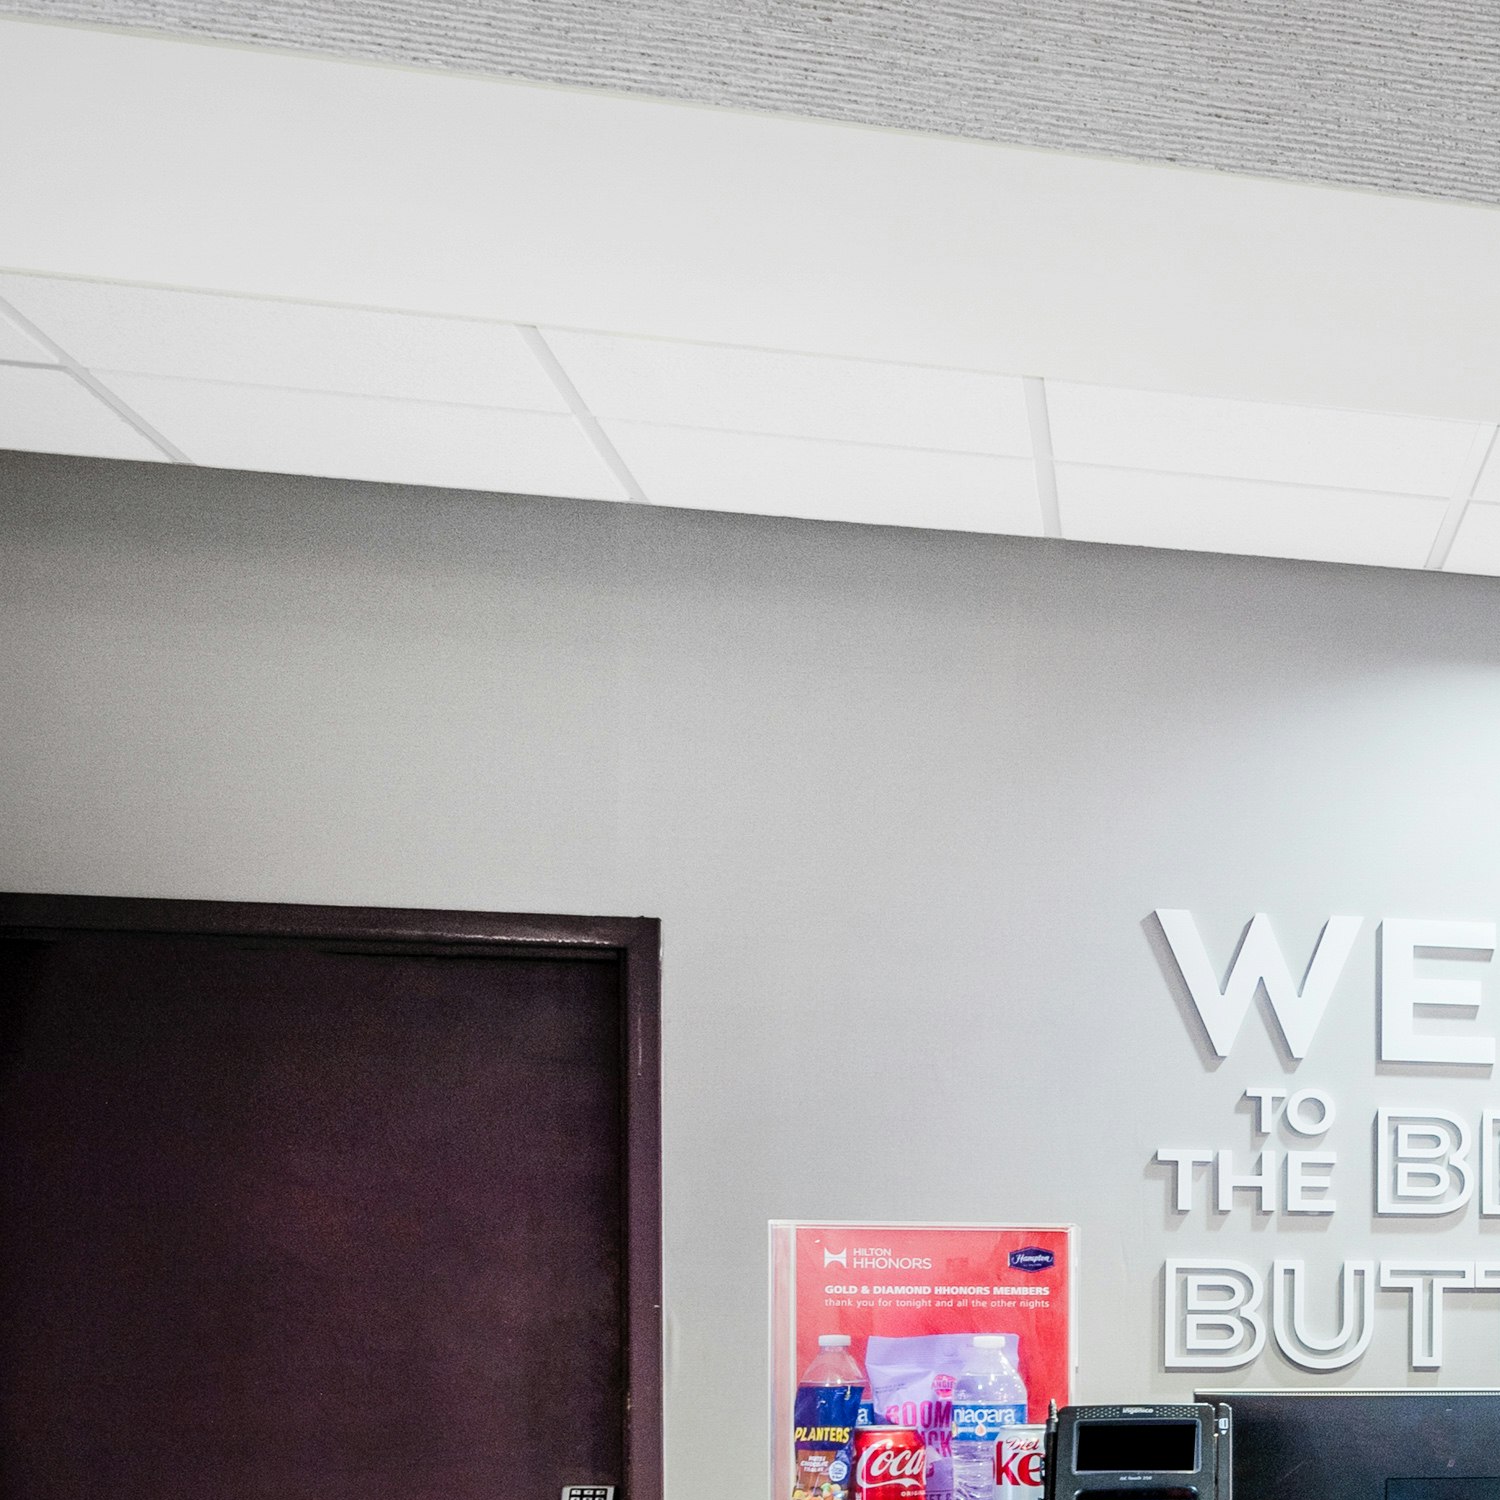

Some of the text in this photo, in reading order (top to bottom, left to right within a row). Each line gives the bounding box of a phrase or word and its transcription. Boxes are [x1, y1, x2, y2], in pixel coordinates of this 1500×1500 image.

[1246, 1087, 1336, 1136] TO
[1156, 1147, 1337, 1214] THE
[853, 1248, 932, 1270] HILTON HHONORS
[1011, 1253, 1054, 1264] Hampton
[825, 1285, 1050, 1296] GOLD & DIAMOND HHONORS MEMBERS
[825, 1298, 1050, 1309] thank you for tonight and all the other nights
[953, 1407, 1016, 1424] niagara
[795, 1427, 850, 1443] PLANTERS
[1006, 1437, 1040, 1450] Diet
[857, 1439, 927, 1484] Coca
[994, 1441, 1045, 1487] ke
